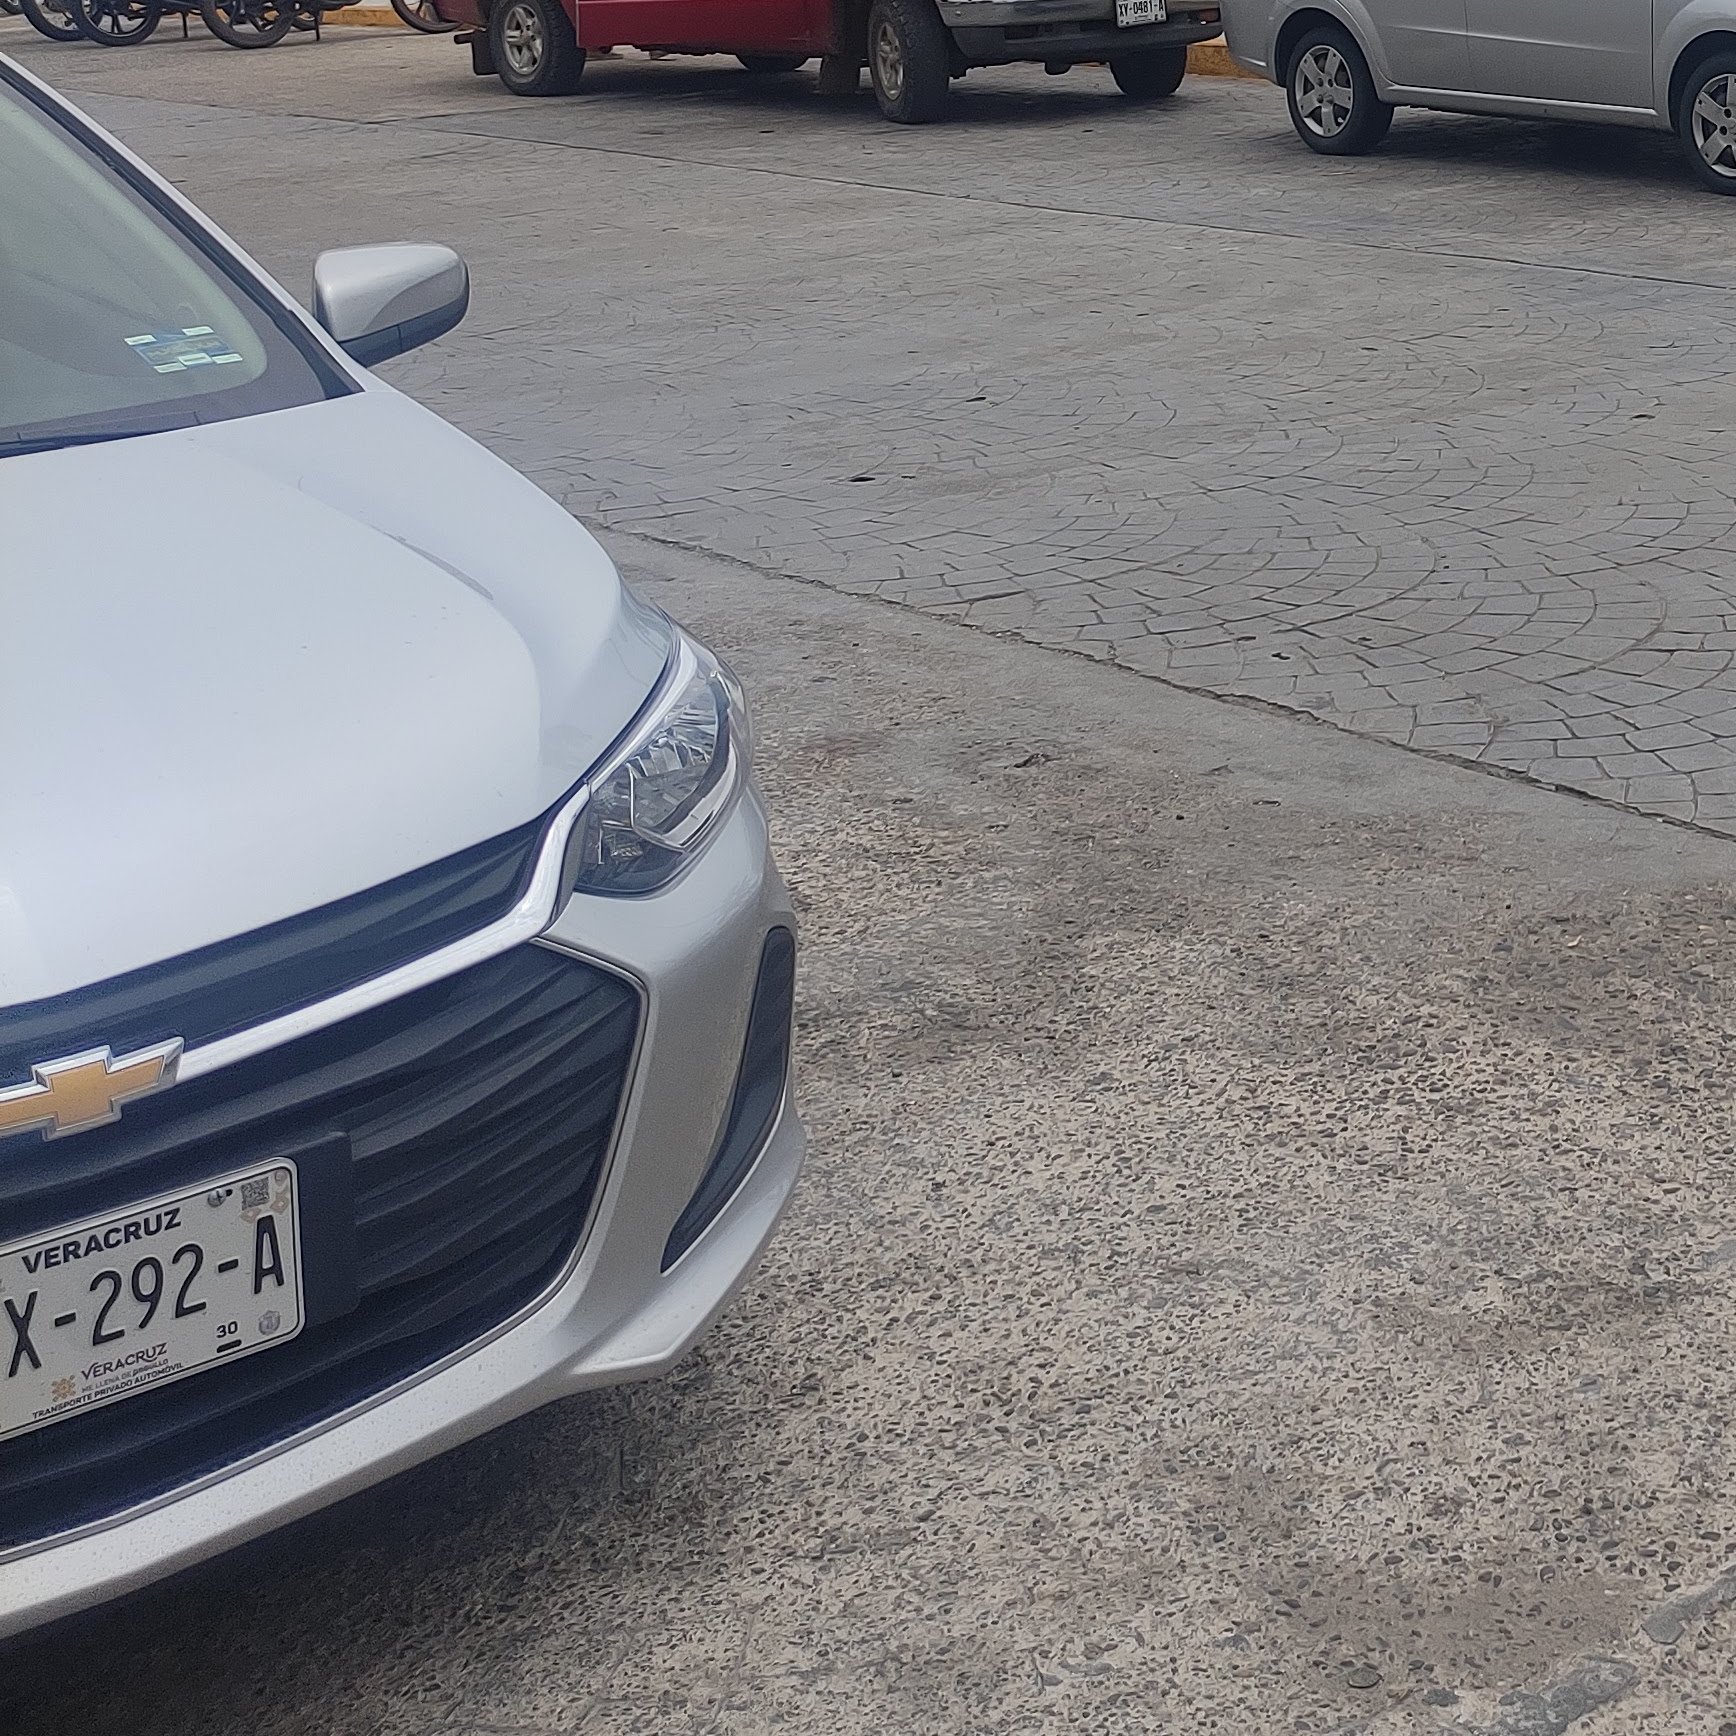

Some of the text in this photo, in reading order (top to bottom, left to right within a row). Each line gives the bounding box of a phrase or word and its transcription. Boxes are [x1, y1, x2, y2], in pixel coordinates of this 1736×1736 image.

[22, 1208, 182, 1274] VERACRUZ
[216, 1320, 239, 1338] 30
[81, 1342, 168, 1381] VERACRUZ
[32, 1393, 93, 1420] TRANSPORTE
[94, 1379, 133, 1399] PRIVADO
